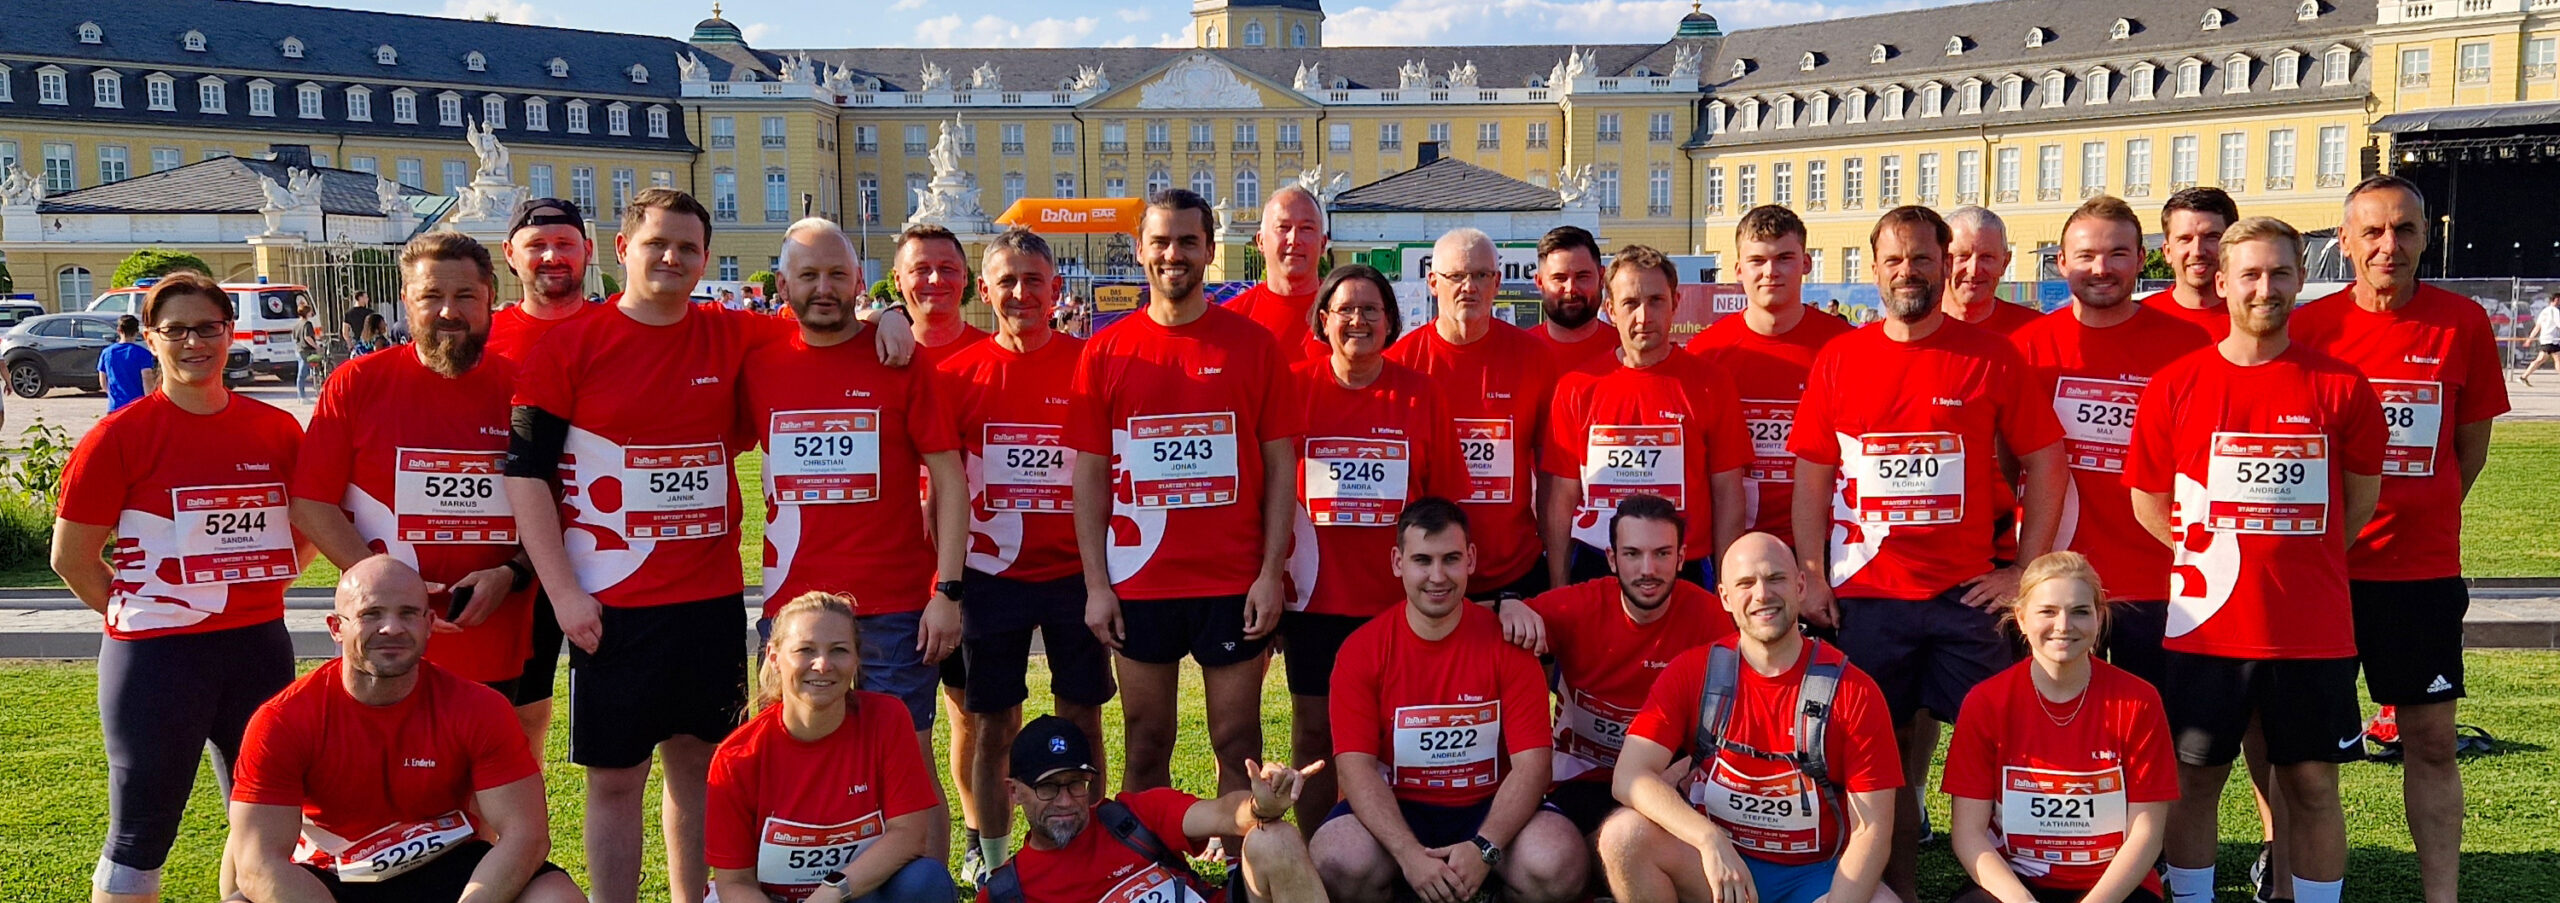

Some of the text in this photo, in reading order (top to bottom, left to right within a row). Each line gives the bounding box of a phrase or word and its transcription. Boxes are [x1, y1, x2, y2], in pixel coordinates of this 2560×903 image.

[2077, 403, 2137, 428] 5235
[2384, 407, 2414, 428] 38
[2096, 427, 2114, 435] MAX
[794, 435, 853, 457] 5219
[1153, 439, 1213, 462] 5243
[1460, 442, 1495, 461] 228
[1006, 448, 1064, 469] 5224
[1170, 463, 1197, 471] JONAS
[1607, 449, 1662, 468] 5247
[1879, 457, 1939, 479] 5240
[649, 470, 709, 493] 5245
[1329, 462, 1385, 482] 5246
[2236, 461, 2305, 485] 5239
[424, 476, 493, 498] 5236
[205, 511, 267, 536] 5244
[221, 536, 254, 545] SANDRA
[1419, 728, 1478, 751] 5222
[1431, 751, 1467, 760] ANDREAS
[1728, 793, 1793, 817] 5229
[2030, 797, 2095, 819] 5221
[1742, 814, 1779, 823] STEFFEN
[372, 835, 445, 873] 5225
[788, 844, 859, 869] 5237
